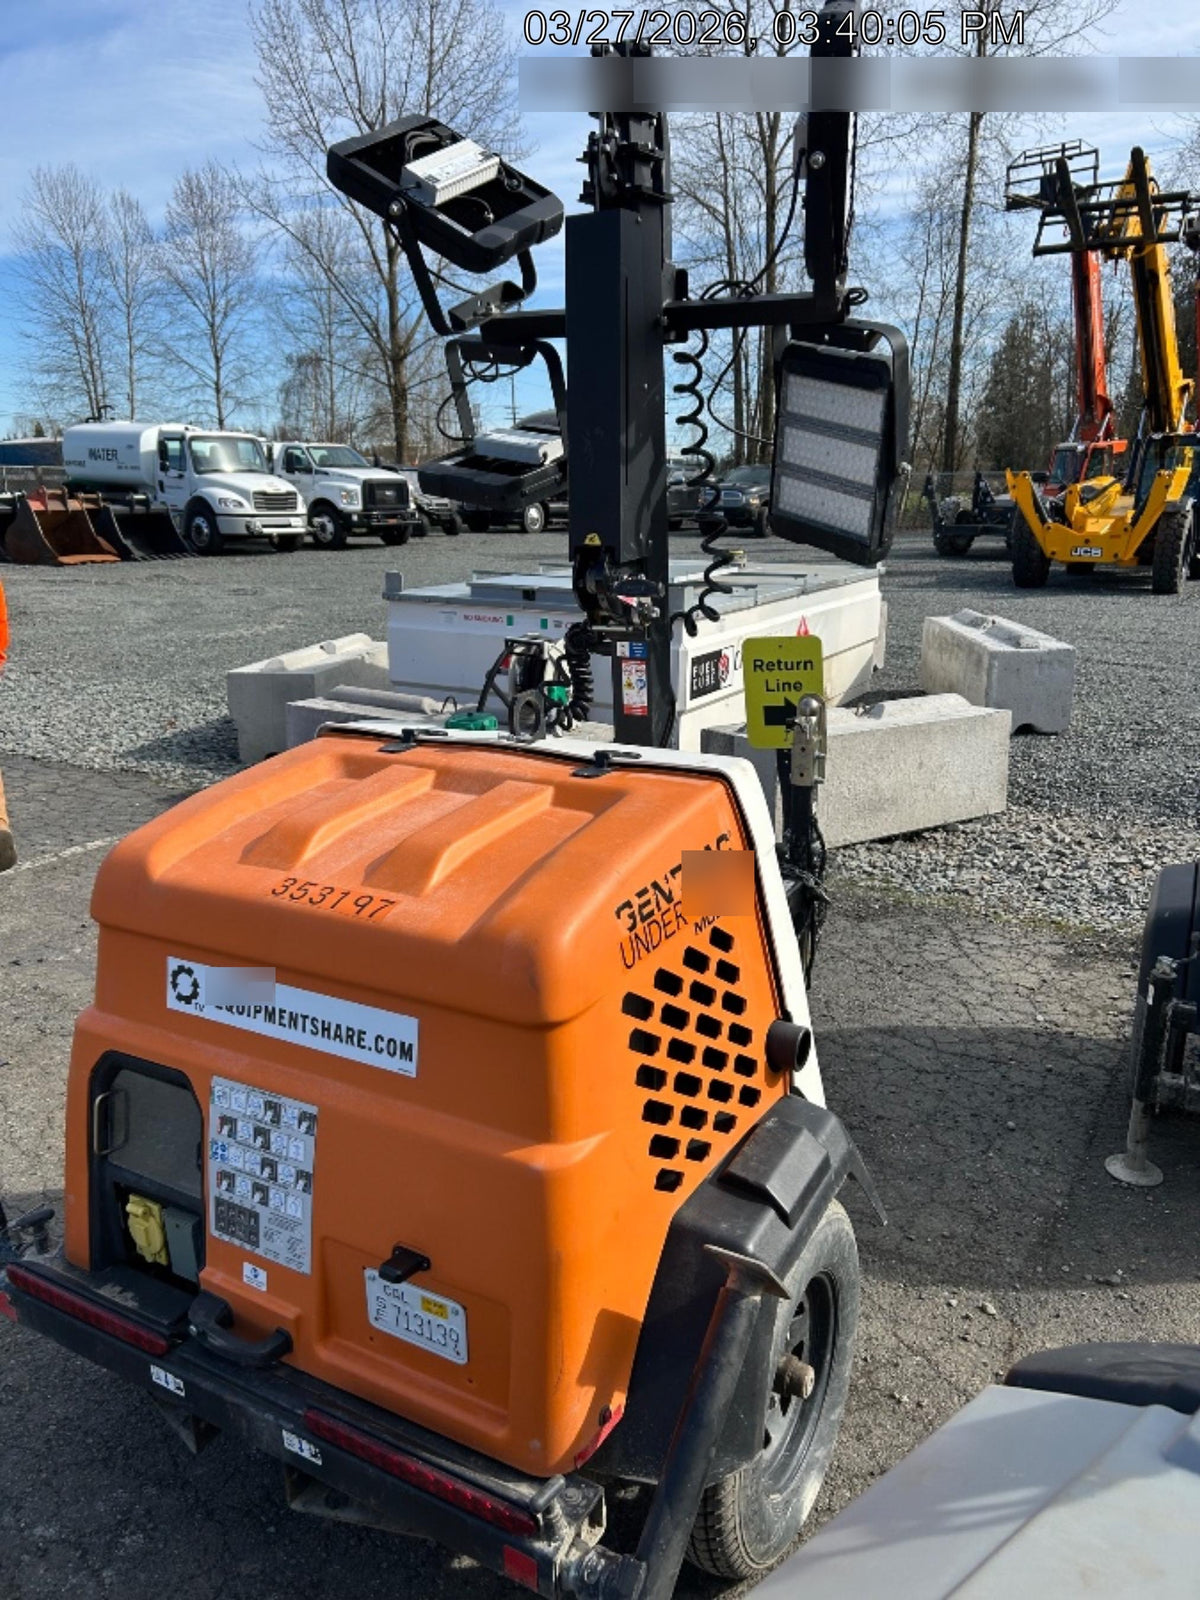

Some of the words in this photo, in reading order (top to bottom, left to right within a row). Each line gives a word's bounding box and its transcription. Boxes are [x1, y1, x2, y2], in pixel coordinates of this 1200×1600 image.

[87, 447, 118, 461] WATER
[1071, 547, 1102, 557] JCB
[692, 659, 717, 678] FUEL
[752, 658, 815, 673] Return
[765, 678, 804, 693] Line
[271, 877, 397, 918] 353197
[390, 1302, 461, 1355] 713139
